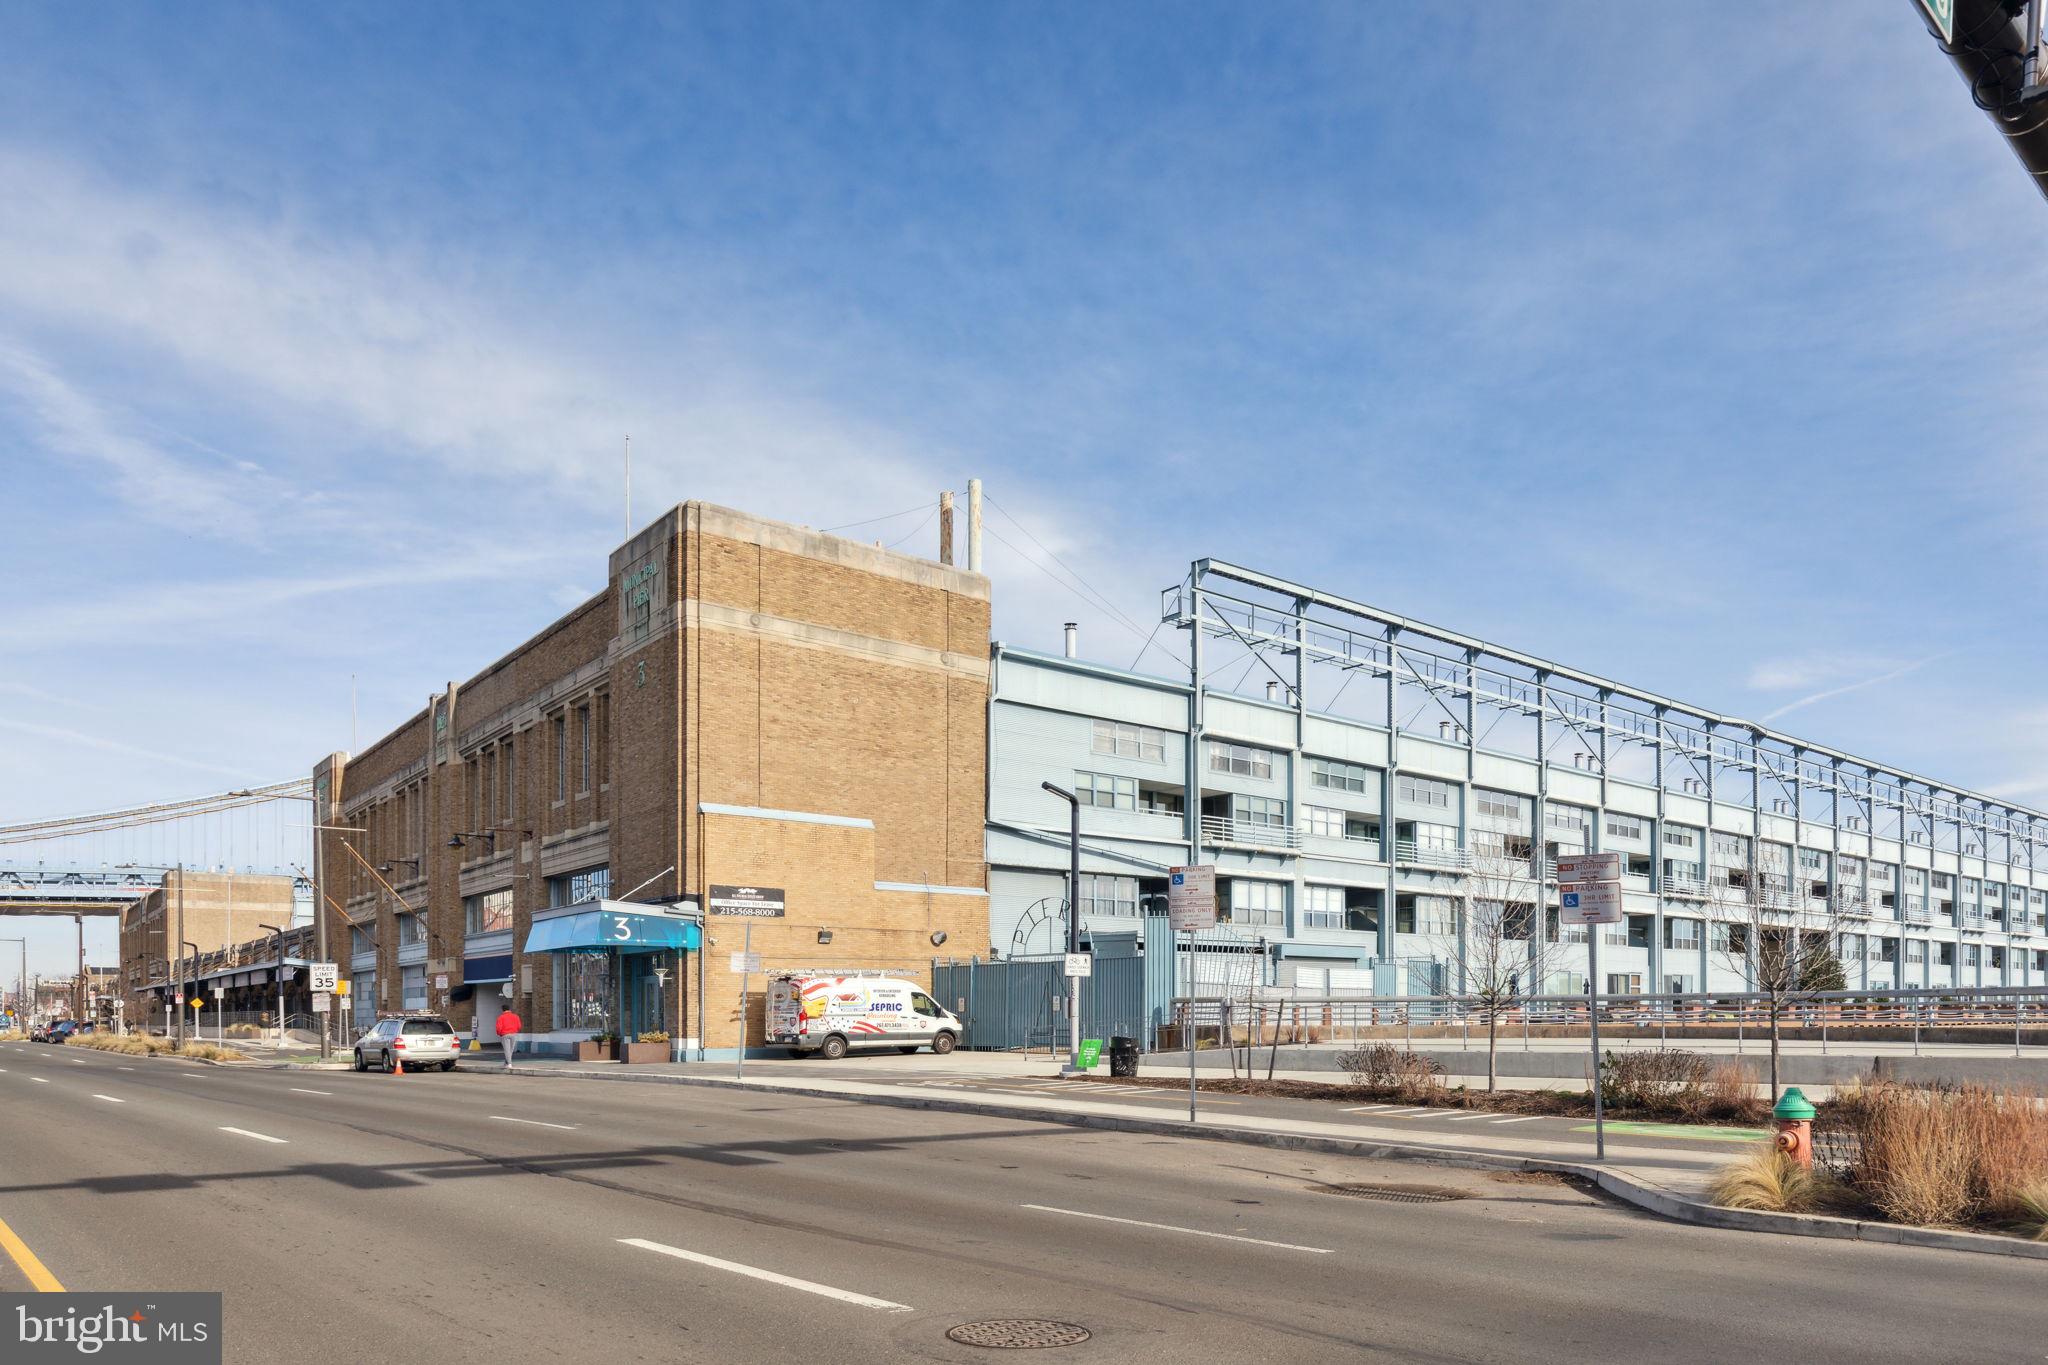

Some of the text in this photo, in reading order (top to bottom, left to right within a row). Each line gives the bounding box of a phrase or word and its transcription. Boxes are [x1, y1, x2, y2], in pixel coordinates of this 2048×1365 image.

[623, 560, 660, 593] MUNICIPAL
[633, 587, 649, 609] PIER
[636, 660, 646, 689] 3
[1575, 863, 1609, 871] STOPPING
[1575, 884, 1609, 892] PARKING
[1598, 893, 1615, 901] LIMIT
[720, 907, 775, 916] 215-568-8000
[614, 916, 631, 940] 3
[315, 978, 334, 988] 35
[869, 1003, 903, 1012] SEPRIC
[867, 1012, 898, 1020] Painting
